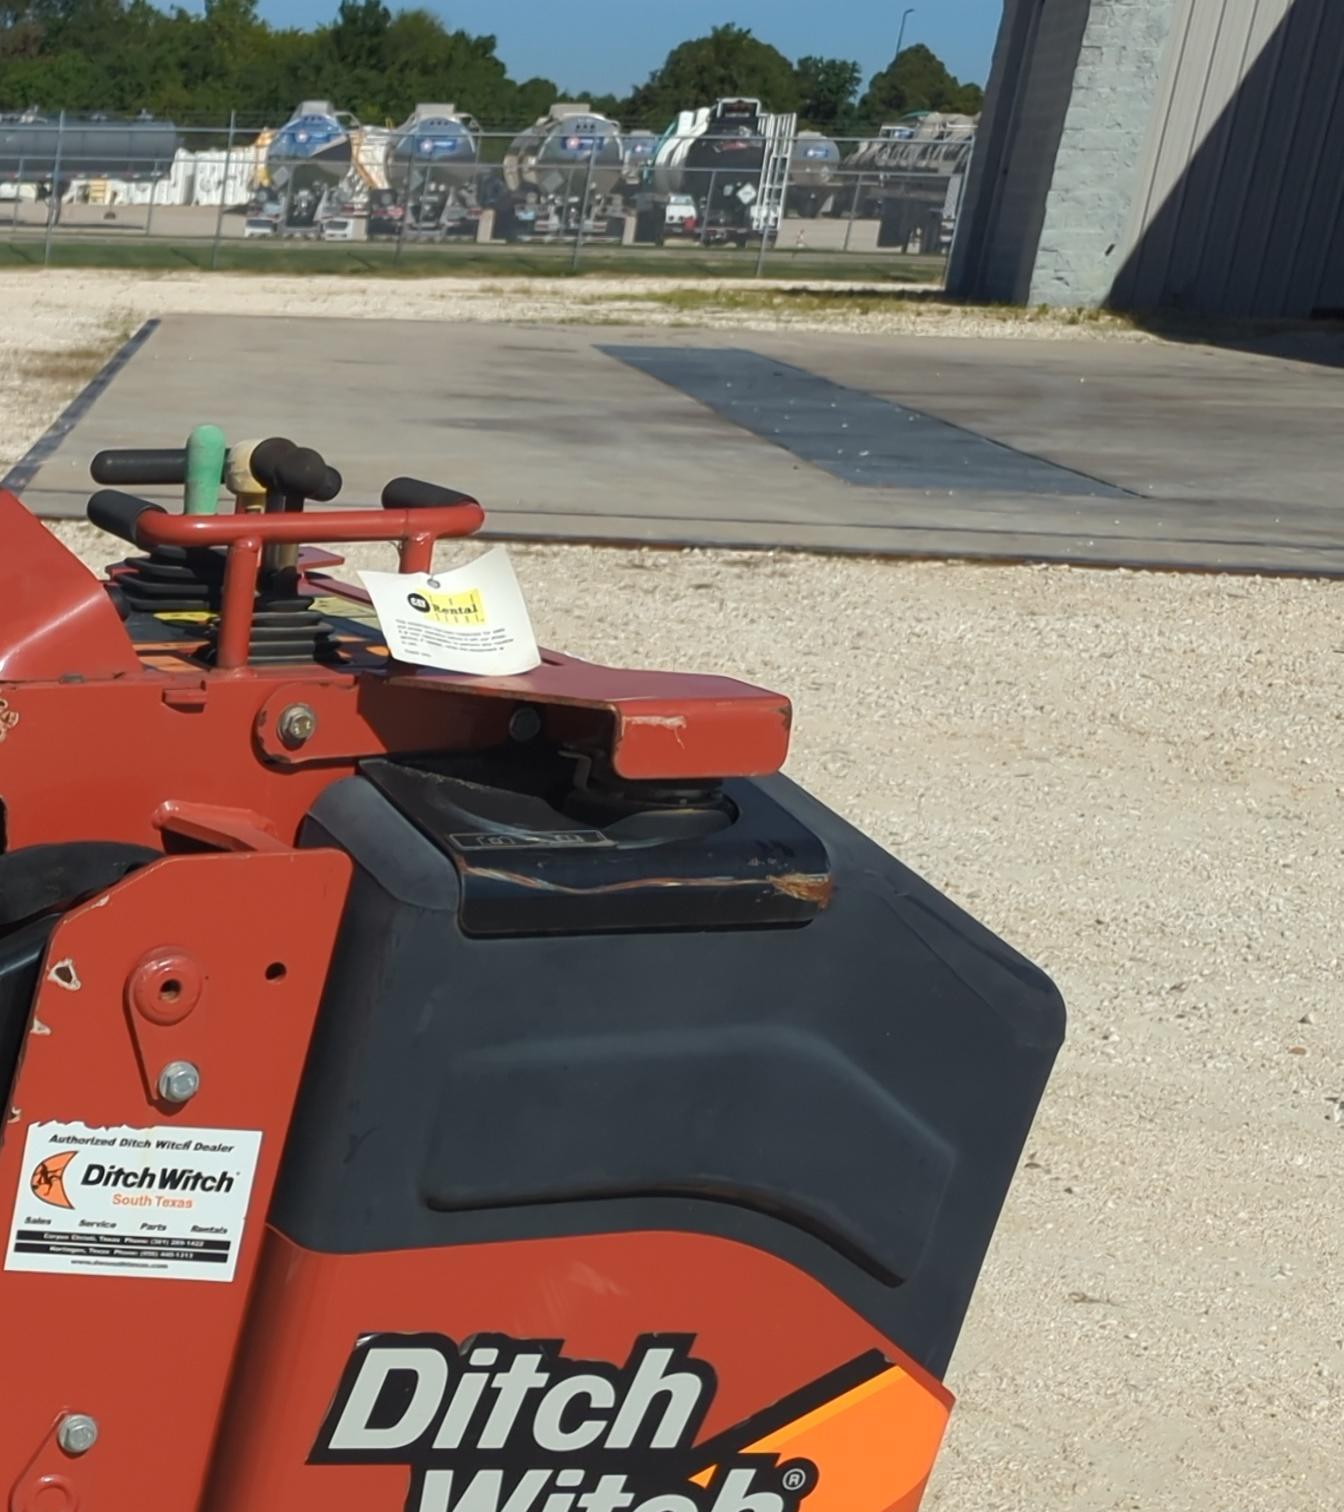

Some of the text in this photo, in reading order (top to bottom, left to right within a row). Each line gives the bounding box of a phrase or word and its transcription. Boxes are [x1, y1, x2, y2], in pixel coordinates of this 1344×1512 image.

[432, 604, 478, 615] Rental
[48, 1134, 116, 1147] Authorized
[119, 1138, 152, 1149] Ditch
[193, 1142, 235, 1153] Dealer
[112, 1193, 193, 1209] South Texas
[24, 1216, 52, 1226] Sales
[78, 1219, 117, 1229] Service
[140, 1222, 167, 1232] Parts
[327, 1347, 703, 1452] Ditch
